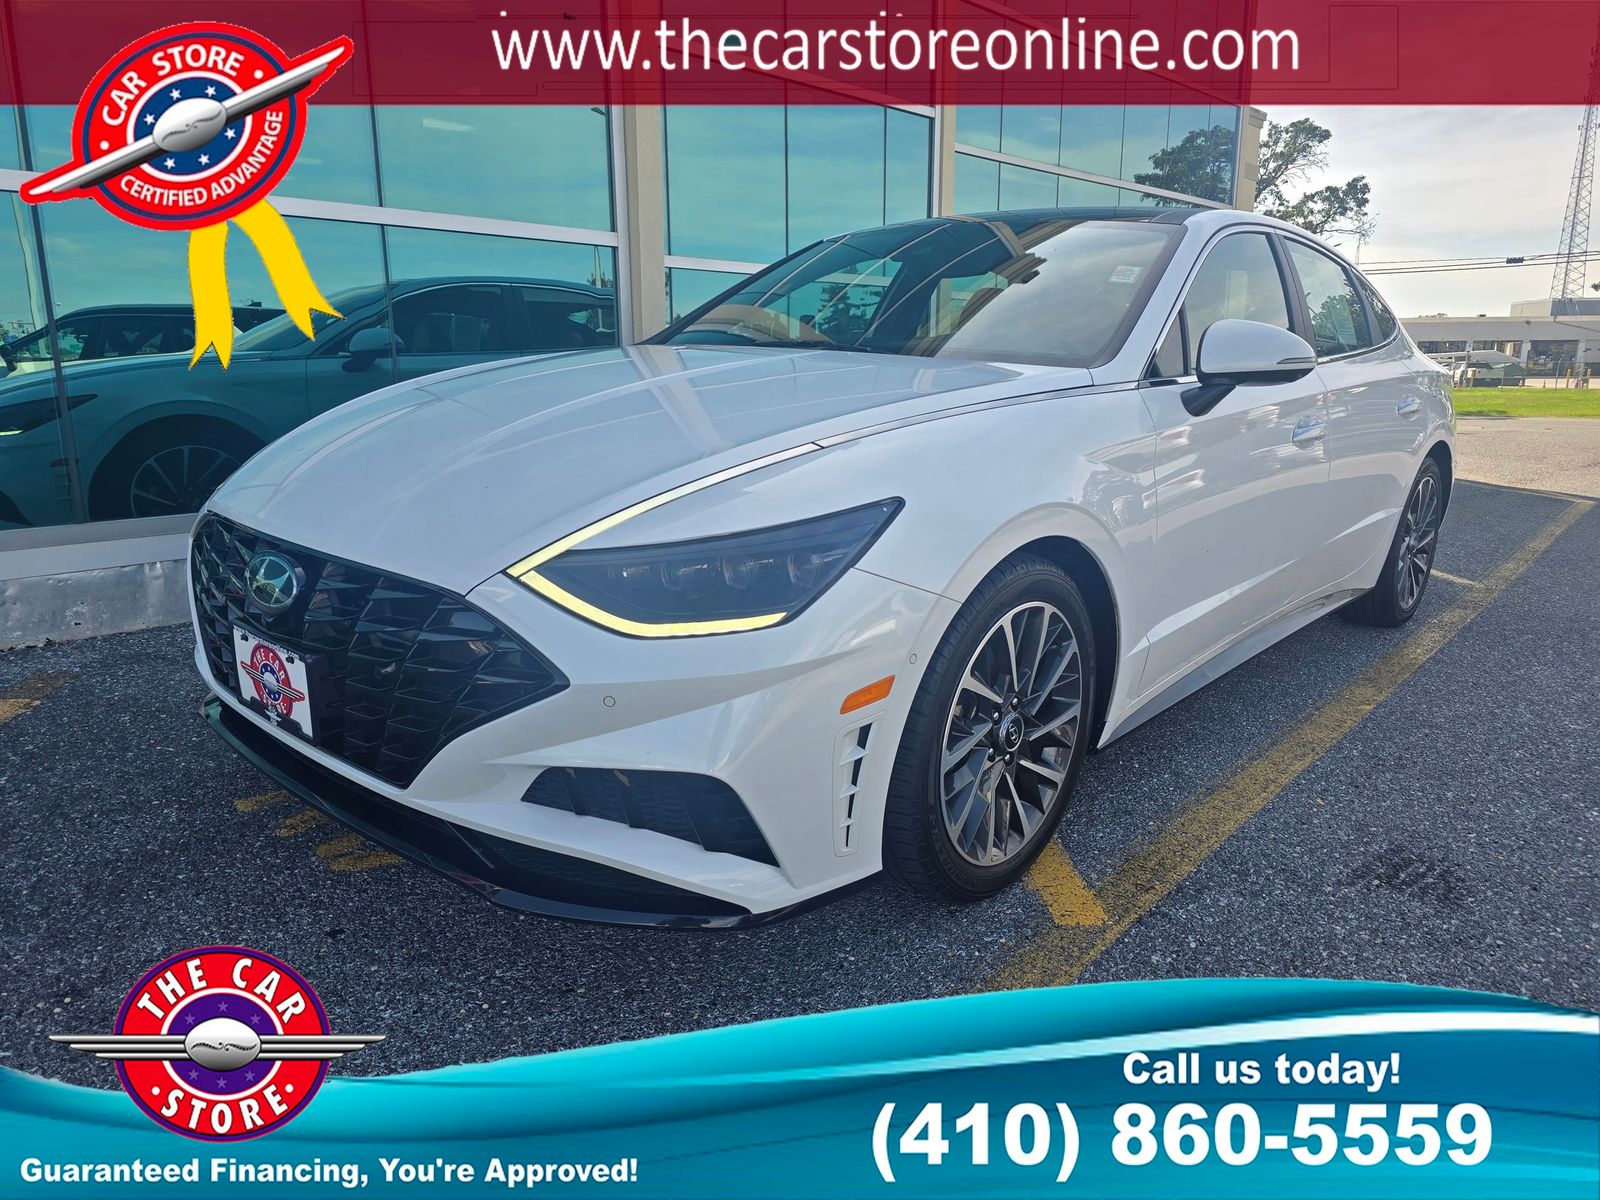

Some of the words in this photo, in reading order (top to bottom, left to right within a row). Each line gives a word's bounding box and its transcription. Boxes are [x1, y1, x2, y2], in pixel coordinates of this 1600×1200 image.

[253, 648, 267, 667] THE
[269, 655, 286, 681] CAR
[263, 694, 287, 714] STRE
